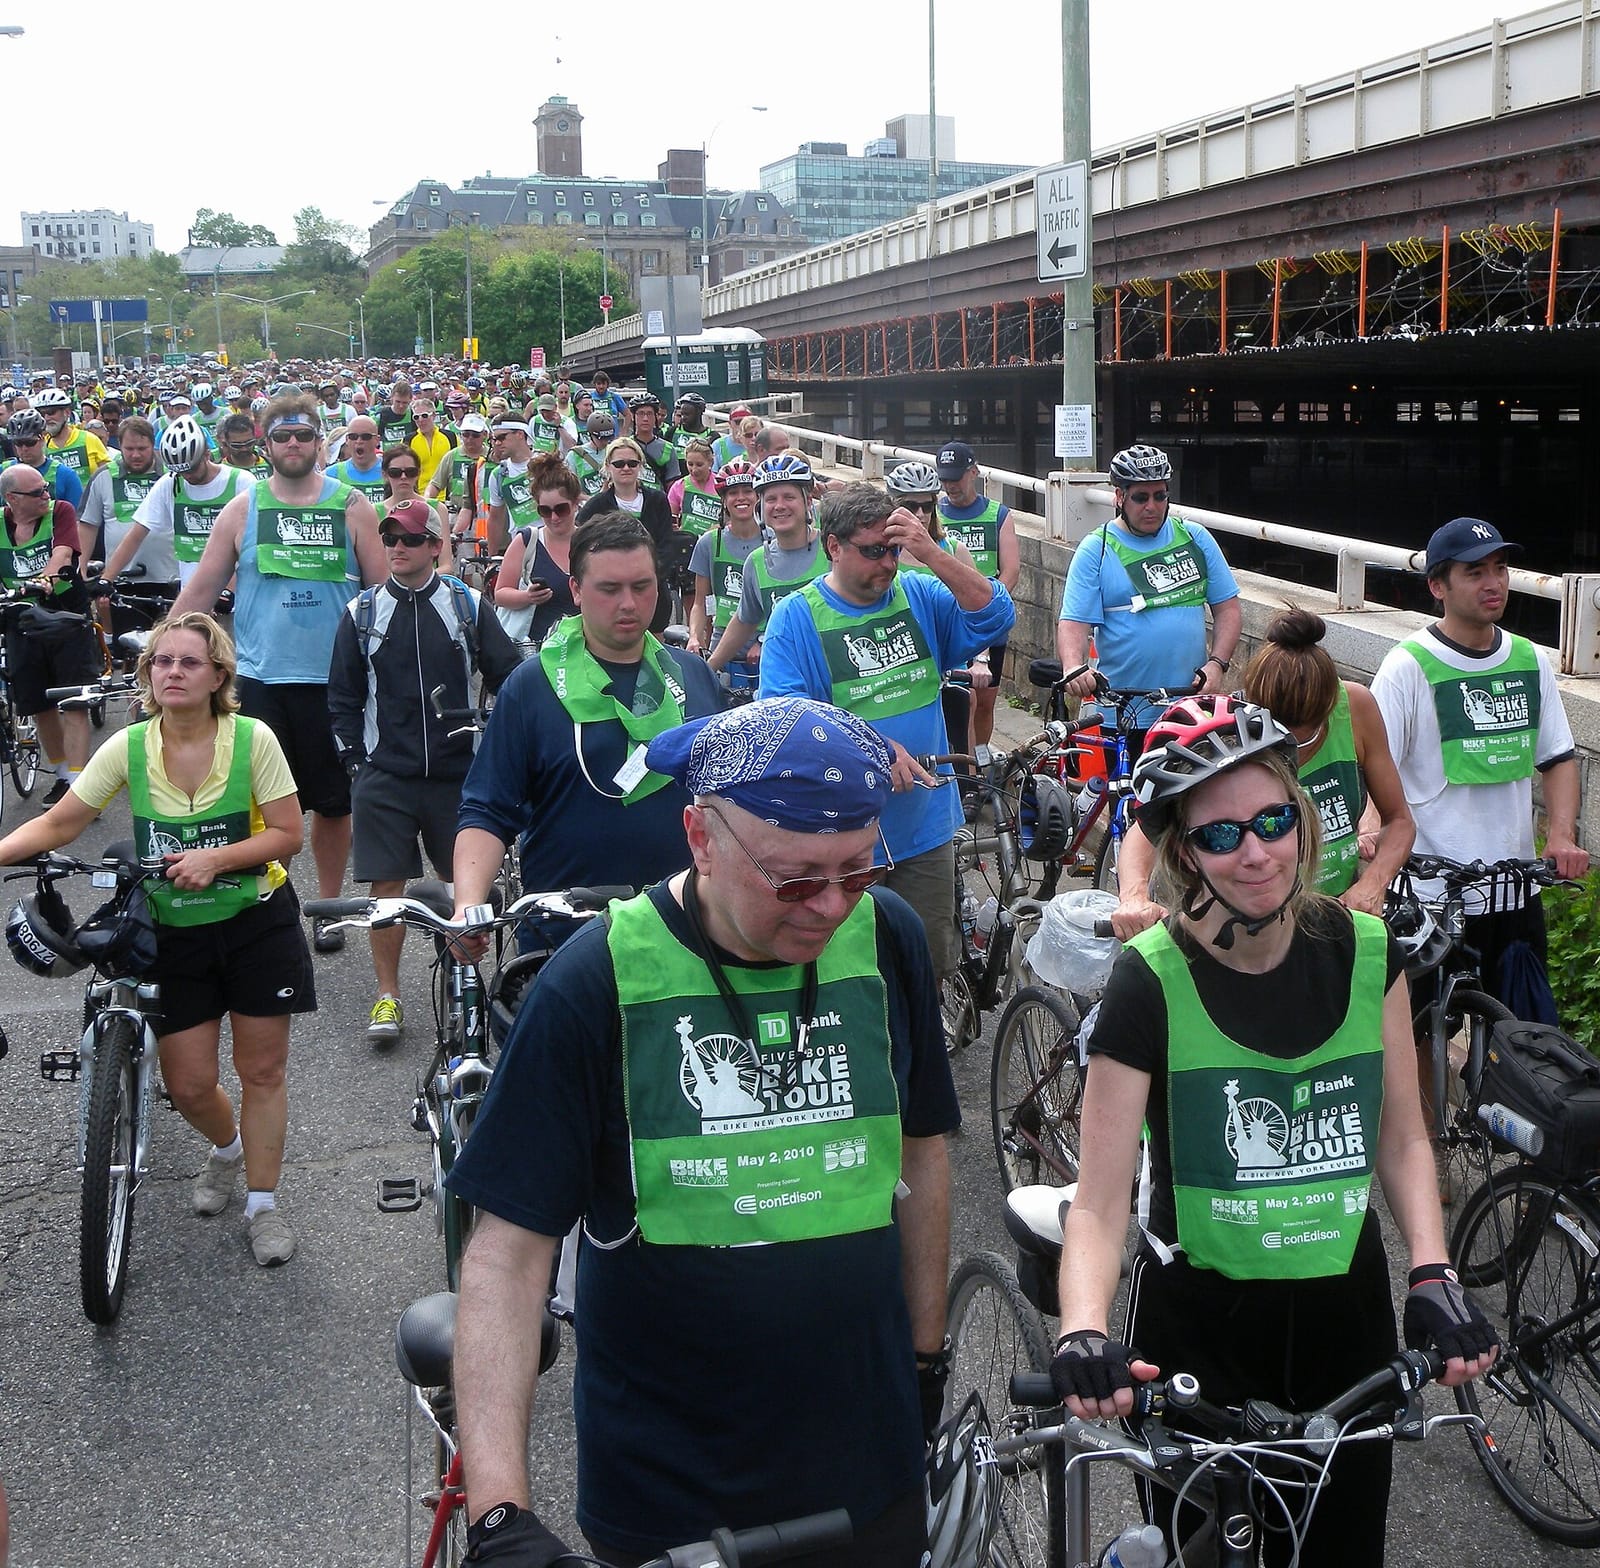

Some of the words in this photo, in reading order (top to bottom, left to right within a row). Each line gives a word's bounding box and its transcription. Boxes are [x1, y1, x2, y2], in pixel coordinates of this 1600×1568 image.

[1049, 176, 1074, 204] ALL
[1043, 208, 1080, 233] TRAFFIC
[1137, 455, 1166, 468] 80589
[762, 471, 790, 482] 18830
[303, 526, 333, 534] BIKE
[1472, 525, 1492, 539] NY
[1170, 559, 1197, 575] BIKE
[1173, 568, 1199, 581] TOUR
[290, 592, 297, 600] 3
[306, 591, 313, 600] 3
[886, 621, 906, 634] Bank
[879, 635, 914, 658] BIKE
[881, 645, 916, 666] TOUR
[1495, 698, 1528, 712] BIKE
[1496, 709, 1528, 722] TOUR
[1312, 778, 1339, 794] Bank
[1320, 800, 1348, 820] KE
[184, 829, 197, 838] TD
[201, 823, 227, 833] Bank
[761, 1018, 787, 1040] TD
[761, 1051, 796, 1063] FIVE
[806, 1044, 847, 1057] BORO
[761, 1055, 850, 1089] BIKE
[1314, 1075, 1355, 1095] Bank
[762, 1081, 852, 1112] TOUR
[710, 1123, 717, 1131] A
[723, 1121, 748, 1131] BIKE
[754, 1118, 775, 1128] NEW
[780, 1114, 807, 1124] YORK
[812, 1109, 847, 1121] EVENT
[1292, 1112, 1314, 1127] FIVE
[1322, 1103, 1359, 1118] BORO
[1290, 1112, 1363, 1146] BIKE
[737, 1154, 764, 1168] May
[769, 1151, 782, 1165] 2,
[784, 1146, 815, 1160] 2010
[825, 1145, 866, 1171] DOT
[1289, 1134, 1365, 1164] TOUR
[670, 1158, 728, 1177] BIKE
[1275, 1169, 1294, 1177] NEW
[1299, 1165, 1325, 1174] YORK
[1330, 1159, 1361, 1169] EVENT
[673, 1176, 697, 1185] NEW
[698, 1175, 729, 1185] YORK
[759, 1189, 822, 1209] conEdison
[1212, 1198, 1259, 1215] BIKE
[1266, 1197, 1288, 1209] May
[1291, 1197, 1303, 1208] 2,
[1305, 1192, 1335, 1204] 2010
[1284, 1230, 1340, 1245] conEdison
